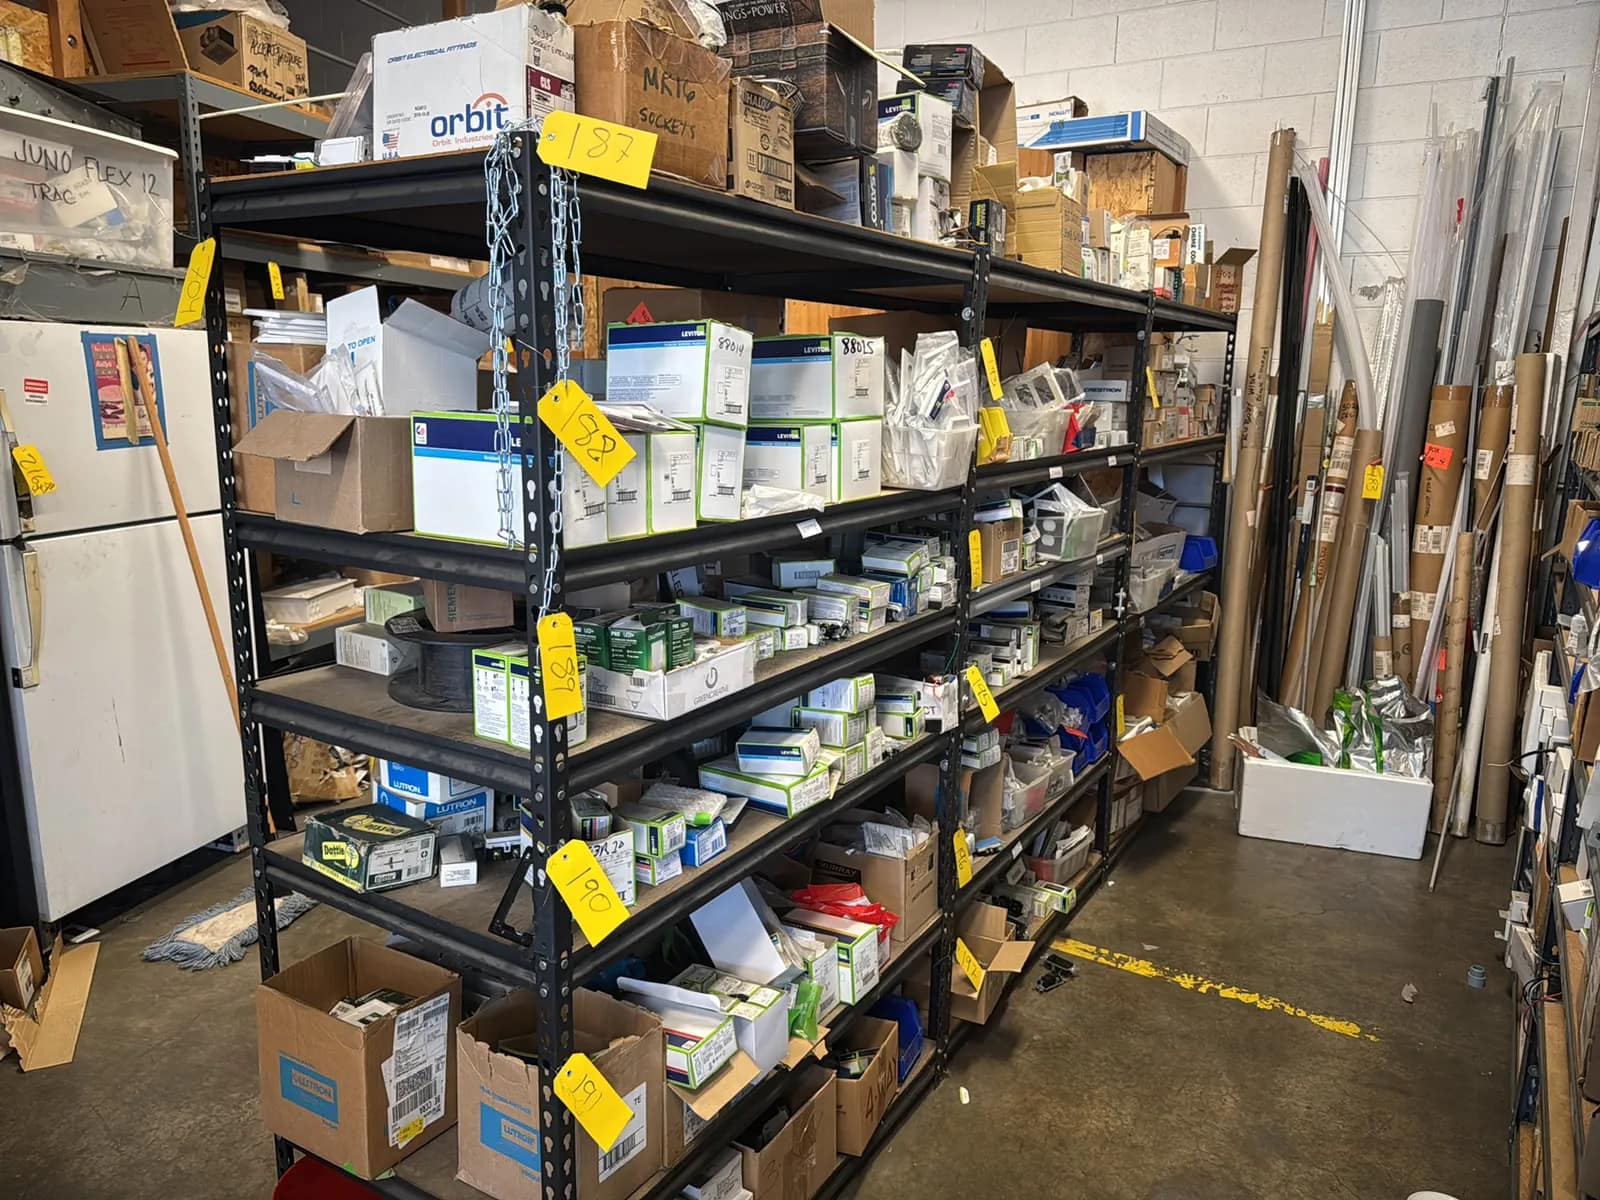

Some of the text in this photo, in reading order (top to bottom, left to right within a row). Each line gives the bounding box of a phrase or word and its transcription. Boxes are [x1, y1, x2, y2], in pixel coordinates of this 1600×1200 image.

[751, 1, 788, 17] POWER
[387, 41, 478, 64] ORBIT ELECTRICAL FITTINGS
[430, 100, 510, 138] orbit
[638, 107, 697, 140] SOCKETS
[432, 138, 452, 148] Orbit
[567, 122, 634, 163] 187
[14, 138, 160, 197] JUNO FLEX 12
[26, 182, 77, 204] TRAC
[868, 175, 878, 224] SATCO
[120, 276, 145, 314] A
[347, 335, 377, 351] TO OPEN
[718, 336, 745, 357] 88014
[803, 346, 832, 354] LEVITON
[548, 644, 576, 692] 189
[392, 779, 422, 794] LUTRON
[436, 797, 477, 814] LUTRON
[323, 844, 345, 857] Dottie
[566, 866, 612, 912] 190
[571, 1073, 603, 1111] 191
